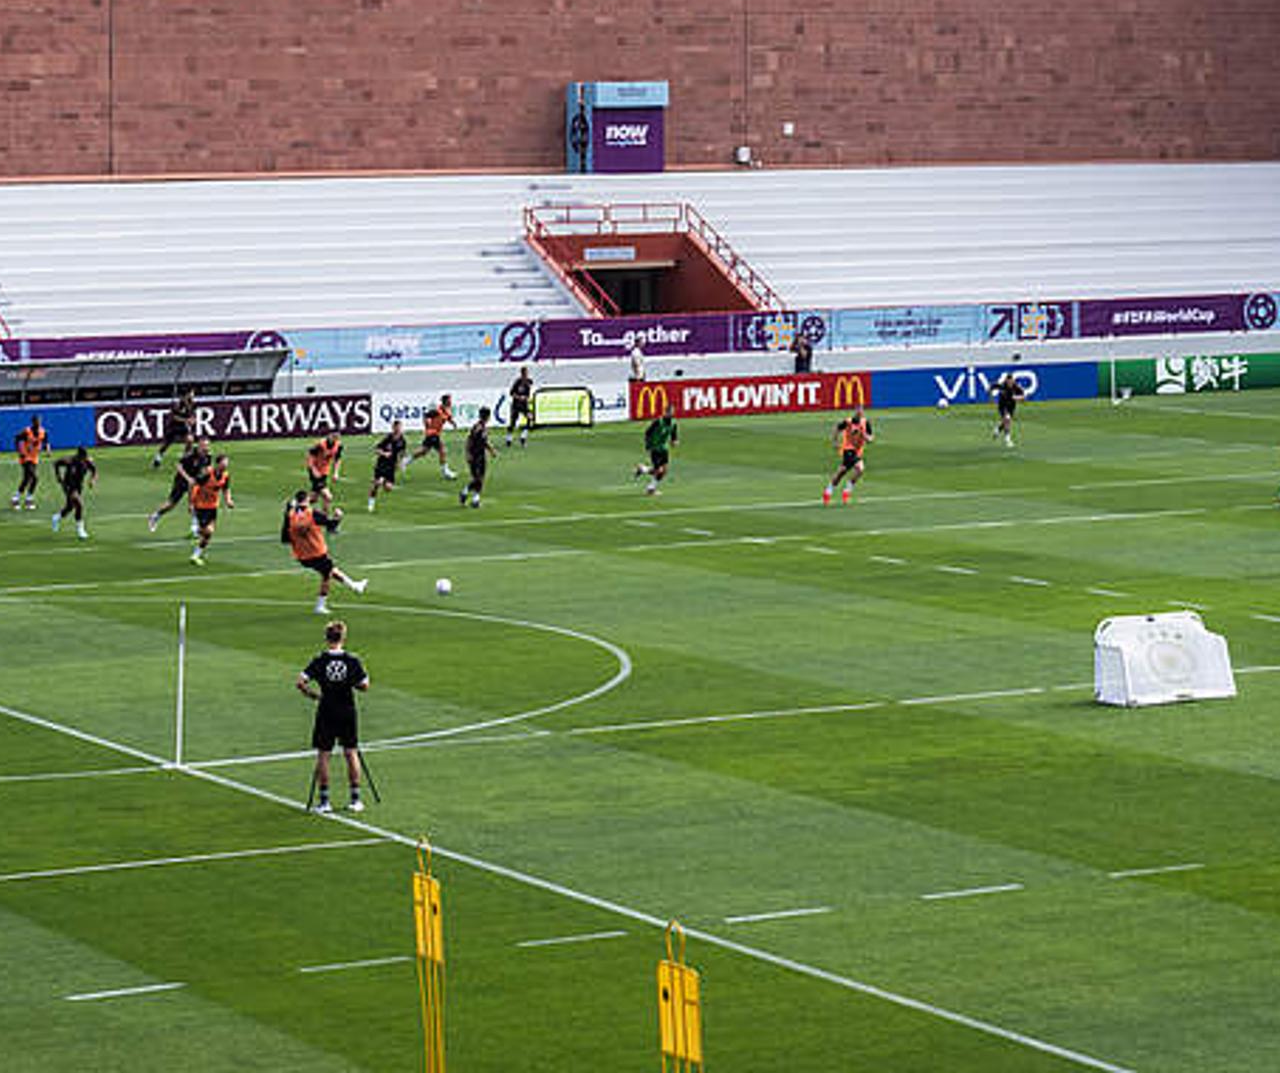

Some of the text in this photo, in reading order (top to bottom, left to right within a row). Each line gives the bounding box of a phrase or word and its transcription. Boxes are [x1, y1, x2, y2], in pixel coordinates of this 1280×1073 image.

[798, 382, 821, 405] IT
[933, 366, 1038, 400] vivo
[96, 399, 370, 443] QATR AIRWAYS
